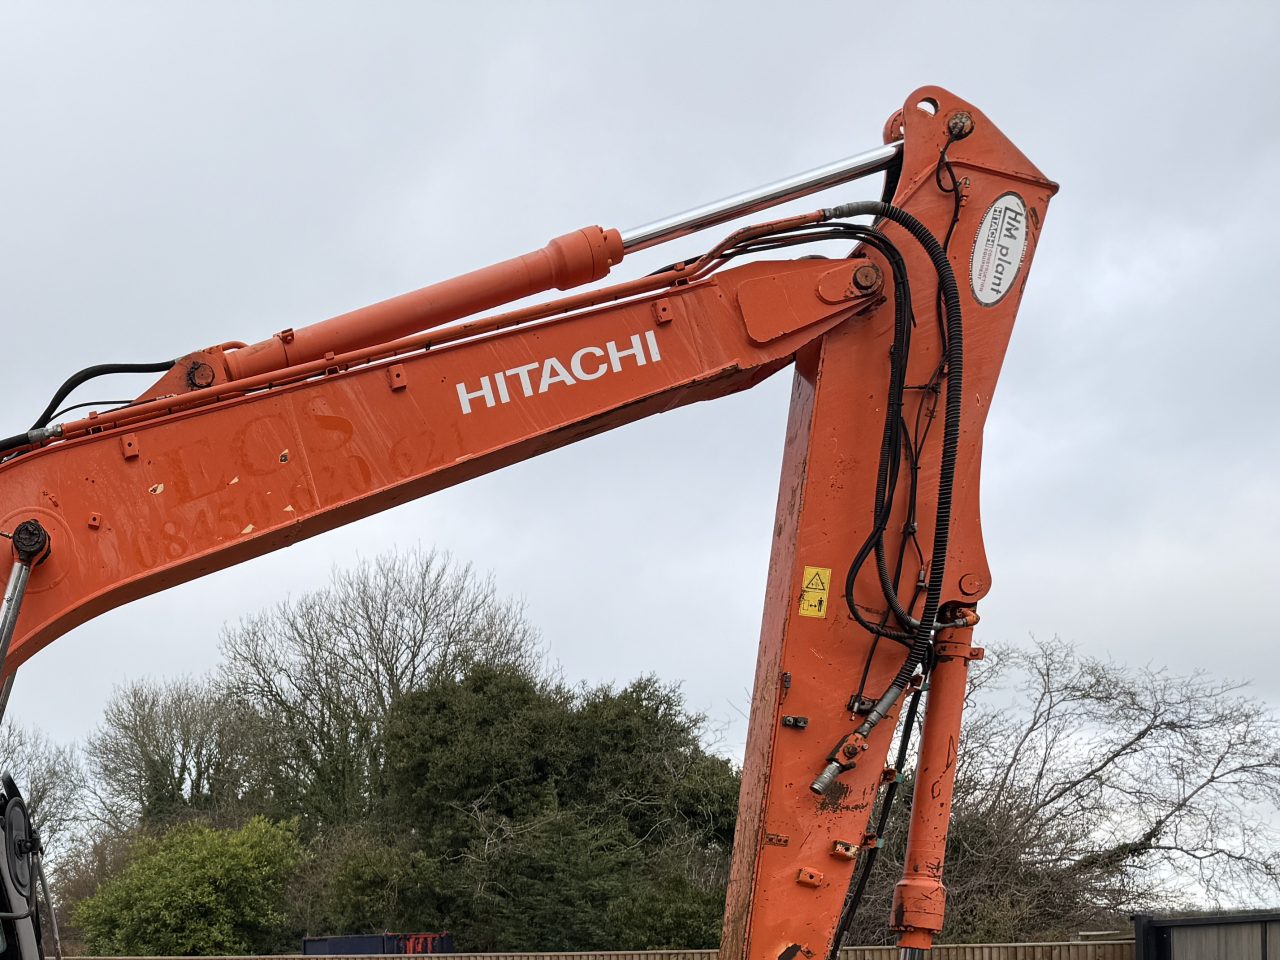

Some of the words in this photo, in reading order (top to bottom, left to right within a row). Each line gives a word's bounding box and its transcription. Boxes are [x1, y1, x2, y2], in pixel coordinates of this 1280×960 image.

[985, 206, 1002, 248] HITACHI
[1003, 206, 1024, 240] HM
[990, 243, 1012, 295] plant
[456, 330, 662, 415] HITACHI
